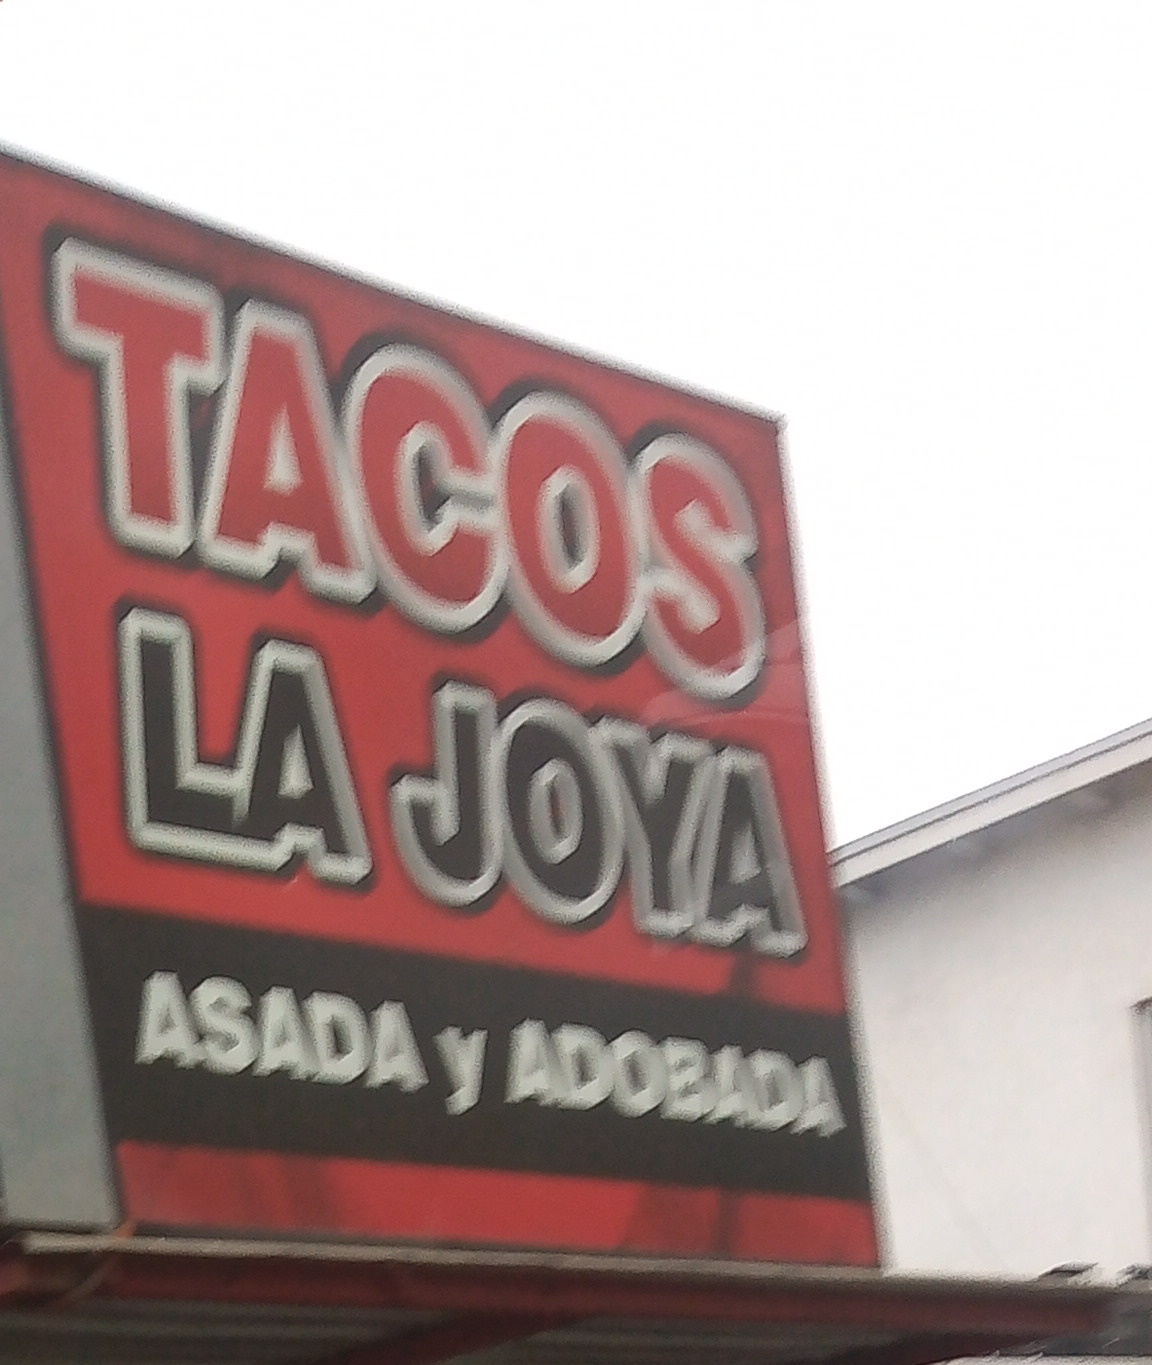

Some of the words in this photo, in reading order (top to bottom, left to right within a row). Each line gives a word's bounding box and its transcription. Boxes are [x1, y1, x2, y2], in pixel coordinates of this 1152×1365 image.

[54, 237, 766, 700] TACOS
[118, 608, 373, 884] LA
[391, 682, 806, 957] JOYA
[136, 972, 428, 1091] ASADA
[436, 1026, 489, 1115] y
[505, 1019, 846, 1136] ADOBADA
